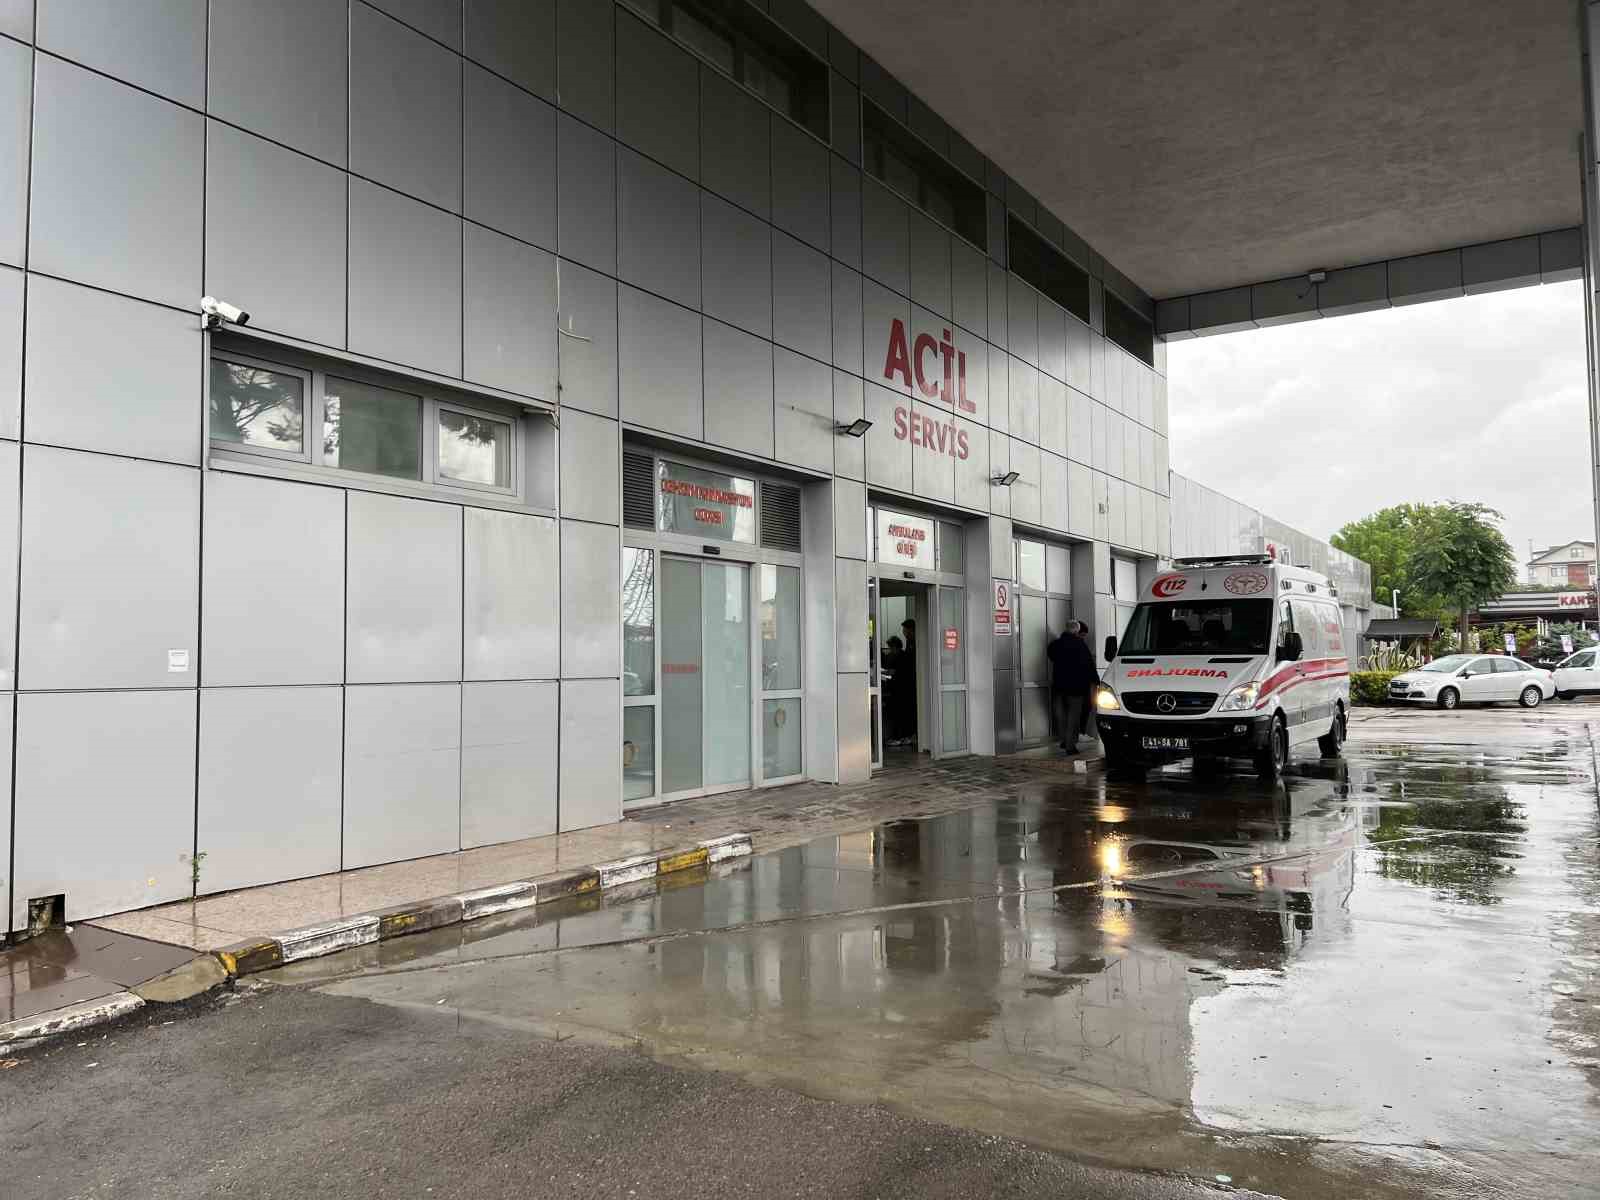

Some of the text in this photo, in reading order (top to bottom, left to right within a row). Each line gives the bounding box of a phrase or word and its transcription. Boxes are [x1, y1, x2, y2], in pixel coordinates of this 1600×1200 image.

[884, 318, 976, 414] ACİL
[894, 406, 968, 460] SERVİS
[1164, 579, 1187, 591] 112
